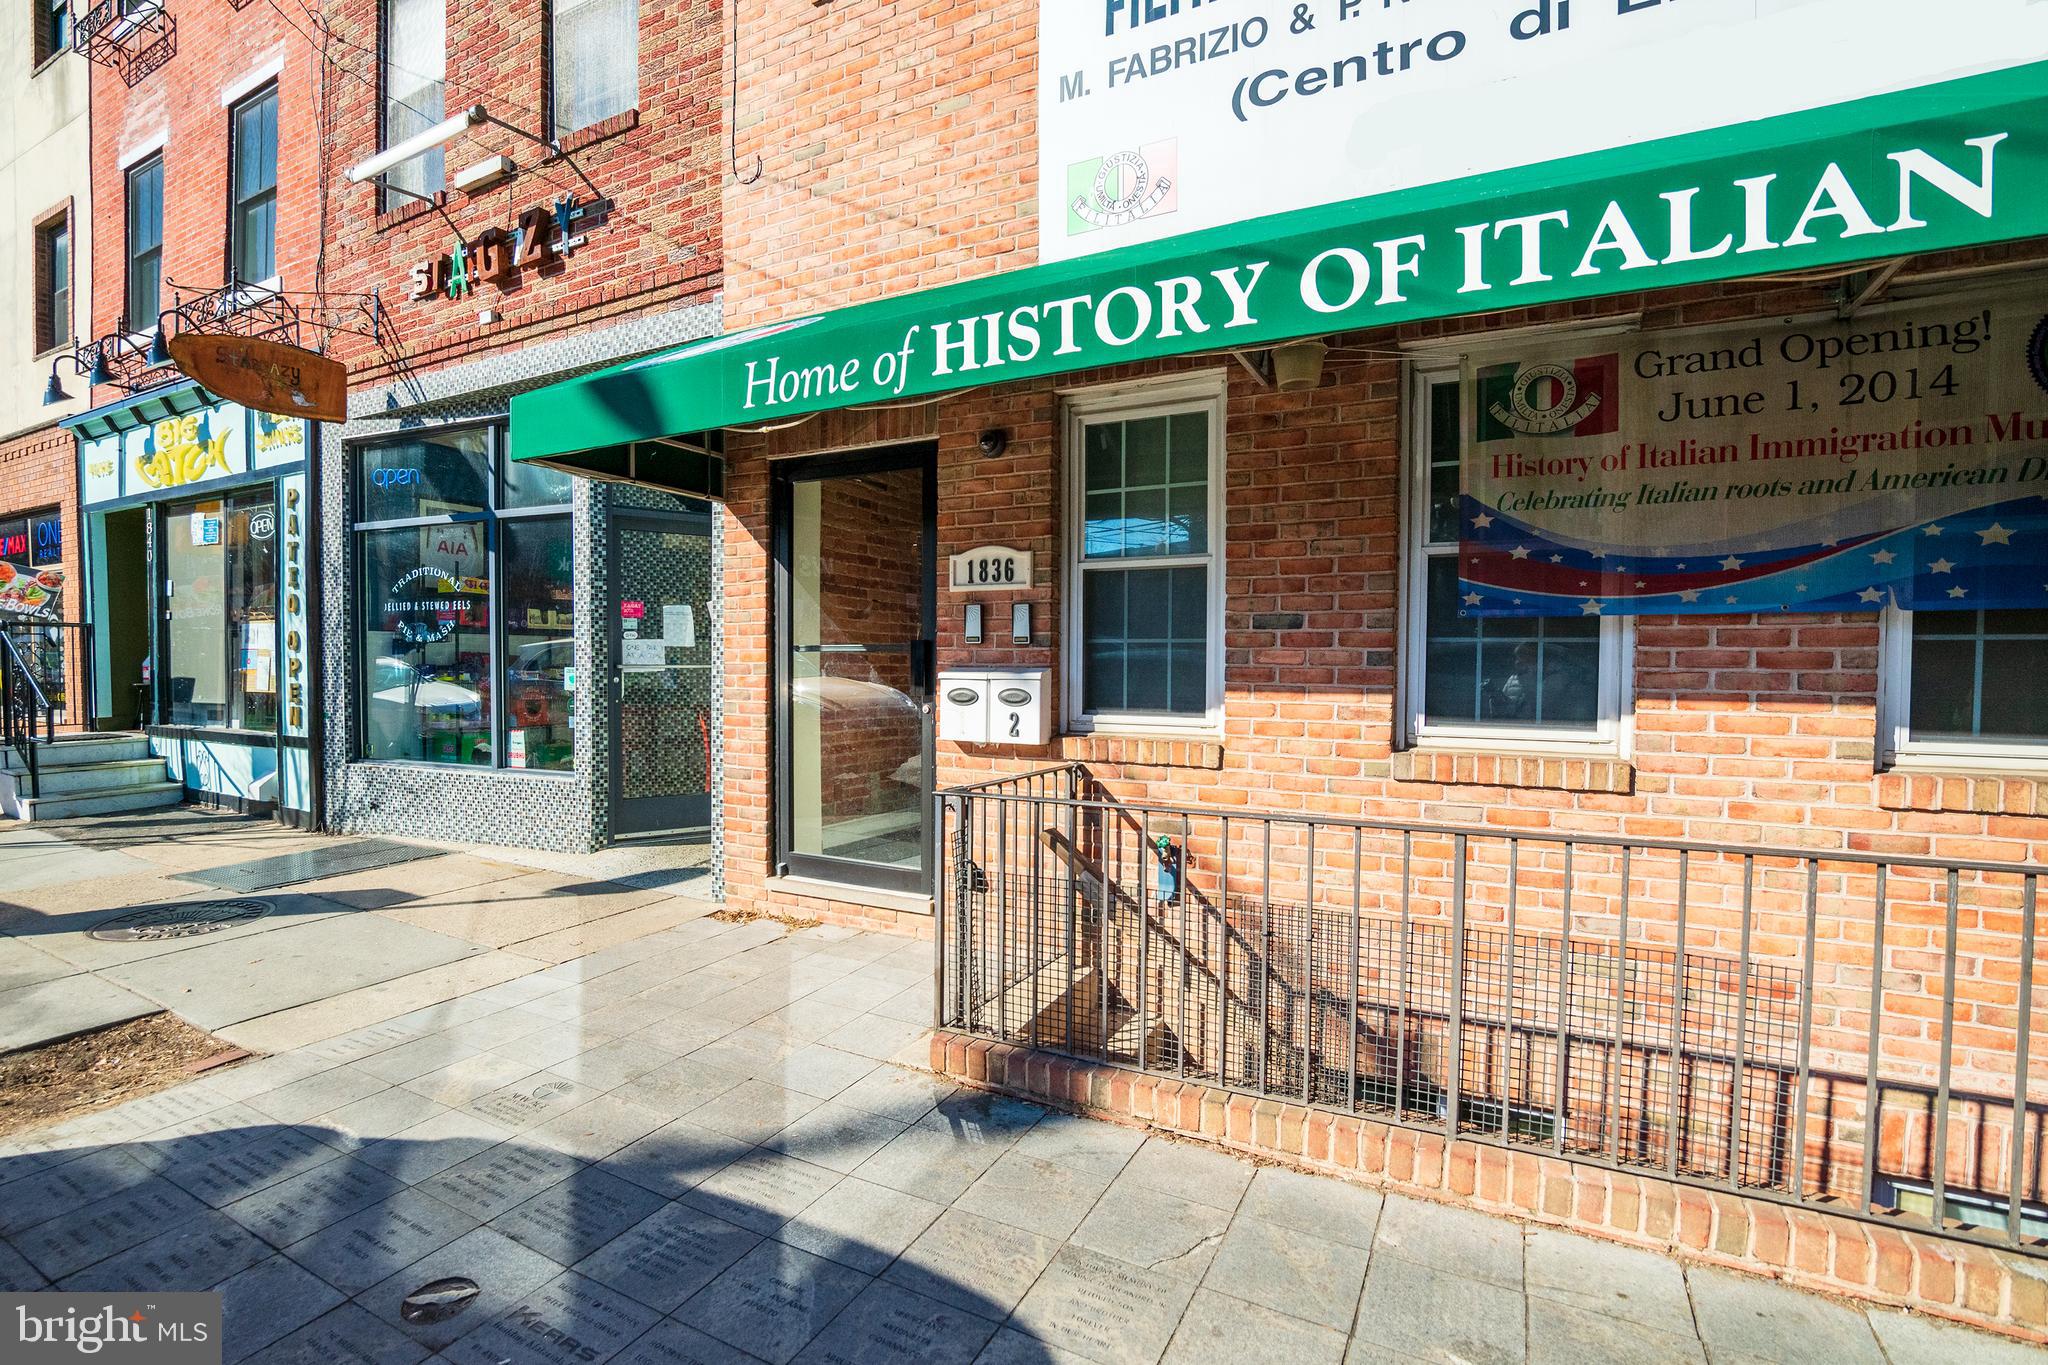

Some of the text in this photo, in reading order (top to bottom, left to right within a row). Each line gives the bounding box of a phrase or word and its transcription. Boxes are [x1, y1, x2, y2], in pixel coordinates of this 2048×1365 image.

[1060, 70, 1091, 103] M.
[1108, 17, 1268, 88] FABRIZIO
[1290, 4, 1316, 34] &
[1231, 0, 1569, 122] (Centro di
[1098, 153, 1145, 181] GIUSTIZIA
[1074, 180, 1171, 226] FILITALIA
[743, 132, 2010, 410] Home of HISTORY OF ITALIAN
[1633, 337, 1765, 380] Grand
[1780, 308, 1992, 375] Opening!
[1489, 391, 1601, 434] FILITALIA
[1657, 363, 1961, 423] June 1, 2014
[155, 415, 200, 450] BIG
[1491, 451, 1594, 483] History
[1600, 443, 1631, 473] of
[1636, 436, 1739, 471] Italian
[1750, 412, 1973, 465] Immigration
[134, 426, 234, 488] CATCH
[372, 468, 421, 489] open
[1496, 456, 2048, 514] Celebrating Italian roots and American D
[251, 517, 273, 535] OPEN
[286, 488, 300, 614] PATIO
[967, 557, 1015, 584] 1836
[391, 566, 463, 594] TRADITIONAL
[384, 600, 412, 612] JELLIED
[421, 601, 450, 612] STEWED
[453, 600, 471, 612] EELS
[397, 620, 413, 638] PIE
[426, 619, 456, 643] MASH
[287, 630, 303, 727] OPEN
[1008, 711, 1020, 738] 2
